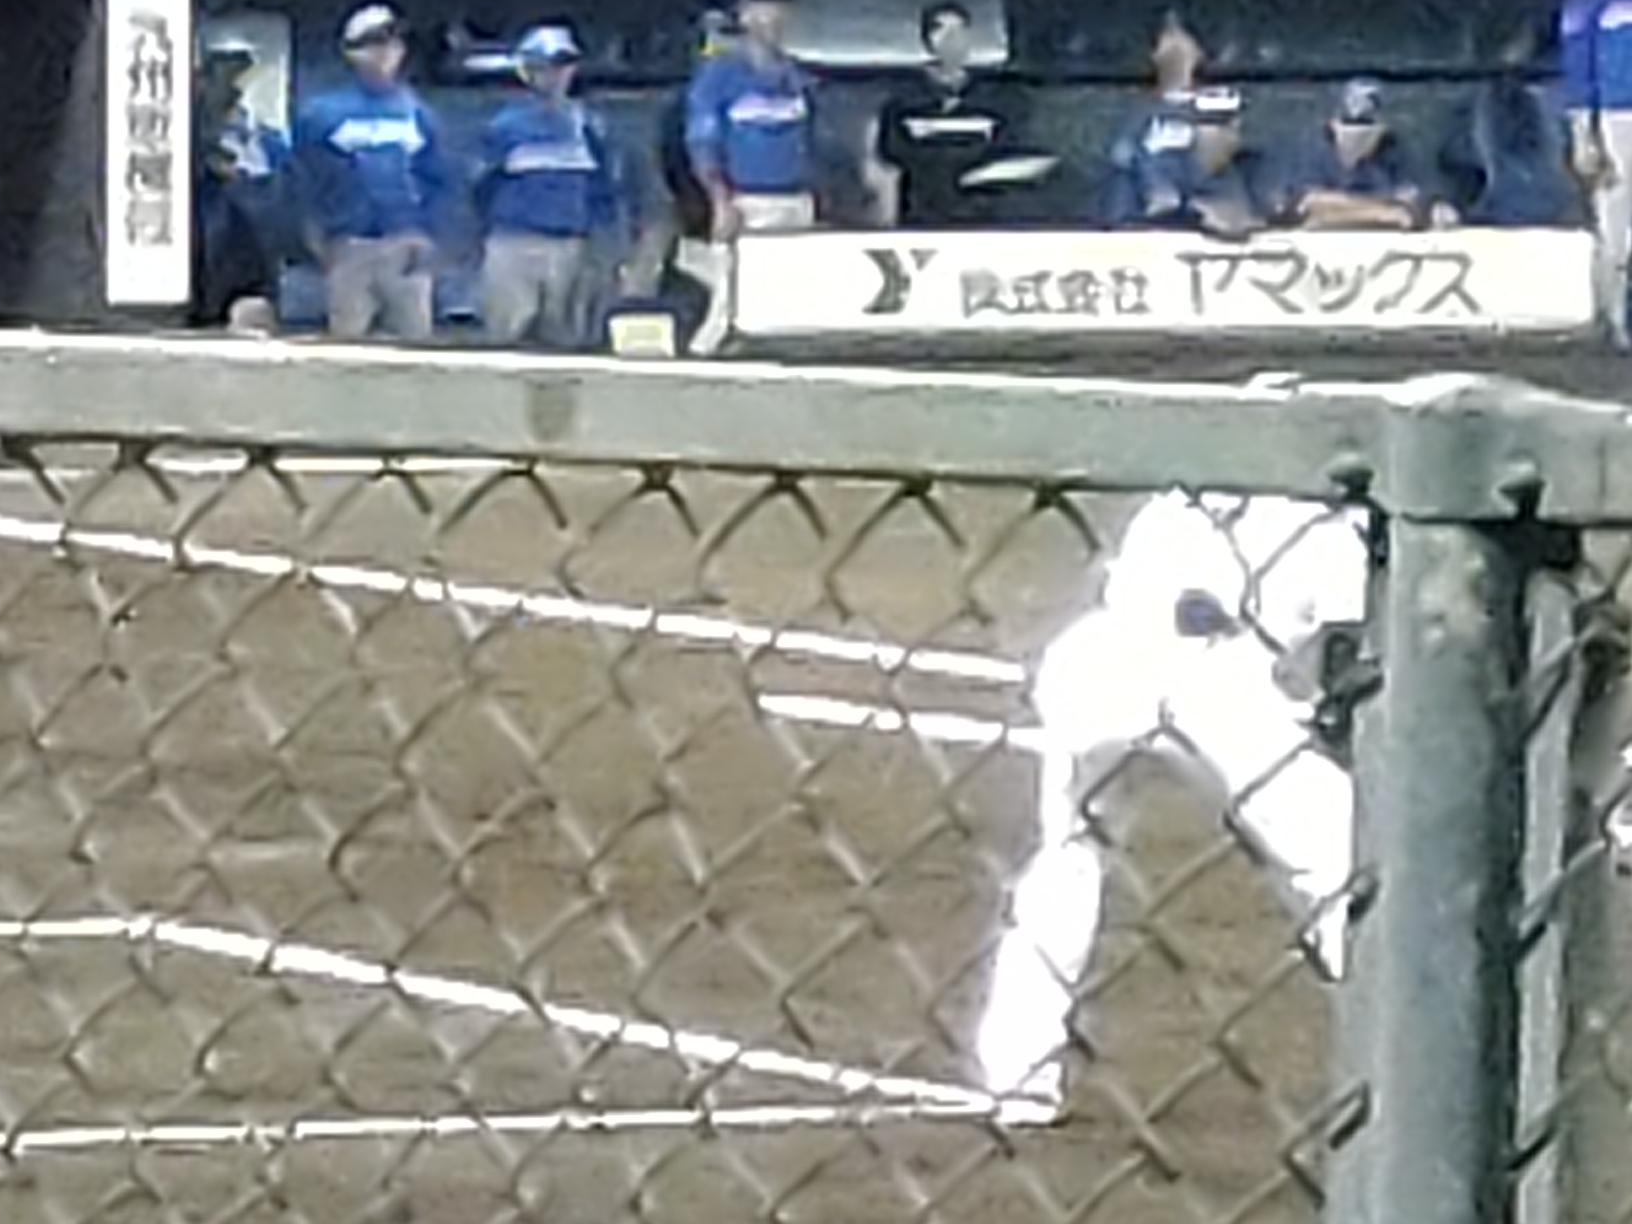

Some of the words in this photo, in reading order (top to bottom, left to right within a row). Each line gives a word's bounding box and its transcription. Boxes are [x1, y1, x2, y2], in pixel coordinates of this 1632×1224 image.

[1174, 248, 1484, 315] ヤマックス
